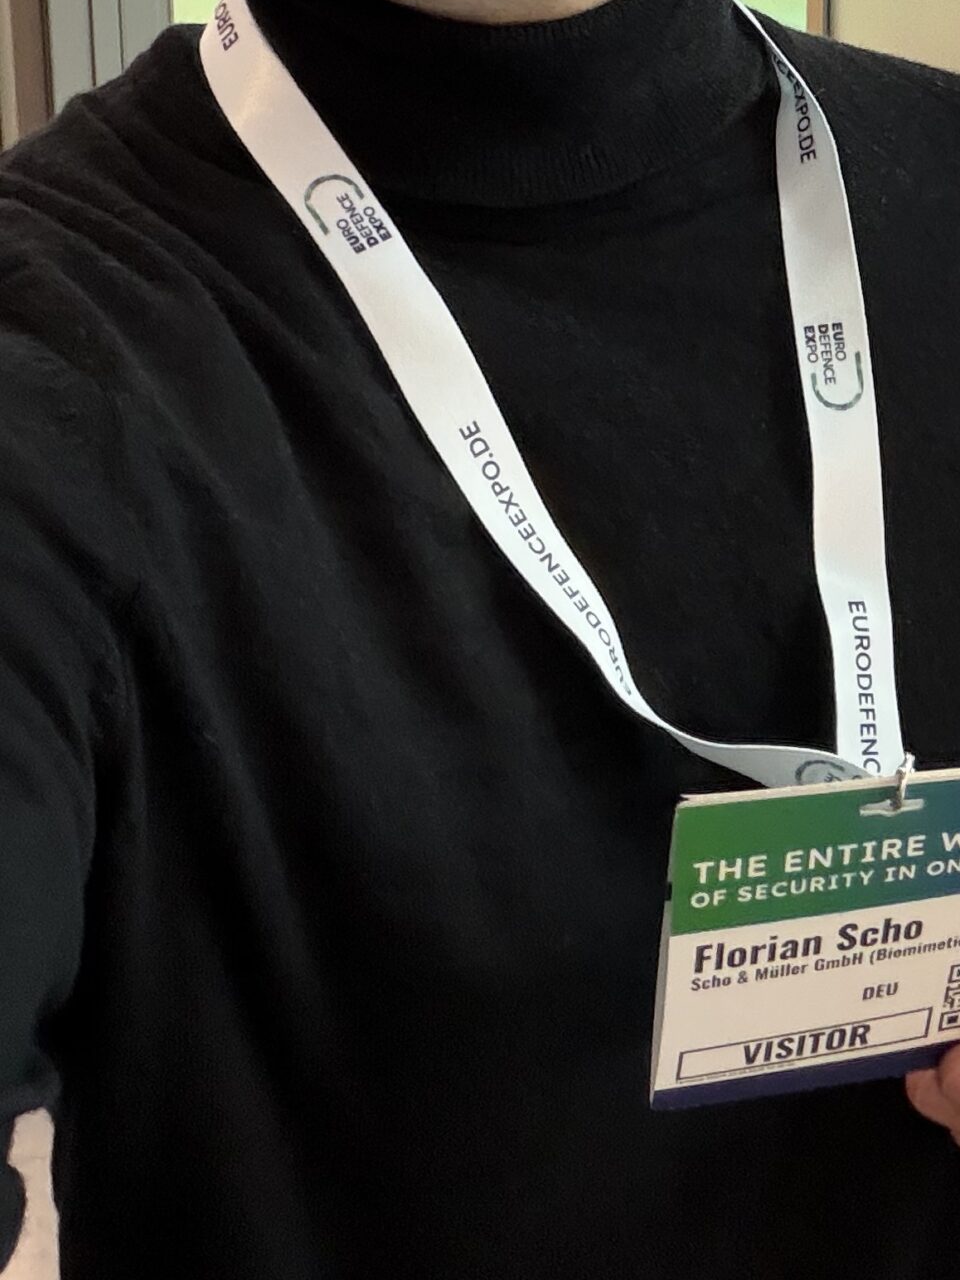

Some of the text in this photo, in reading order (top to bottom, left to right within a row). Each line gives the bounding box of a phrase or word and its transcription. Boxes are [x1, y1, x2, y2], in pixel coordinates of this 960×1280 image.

[336, 192, 380, 248] DEFENCE
[336, 218, 367, 254] EURO
[363, 206, 393, 242] EXPO
[803, 325, 819, 364] EXPO
[818, 323, 837, 386] DEFENCE
[831, 322, 847, 362] EURO
[693, 854, 767, 885] THE
[784, 834, 926, 873] ENTIRE
[690, 888, 728, 909] OF
[736, 869, 875, 903] SECURITY
[883, 864, 916, 883] IN
[693, 917, 924, 975] Florian Scho
[690, 974, 732, 992] Scho
[736, 970, 749, 984] &
[754, 962, 809, 983] Müller
[814, 951, 864, 972] GmbH
[862, 981, 899, 1001] DEU
[743, 1023, 872, 1066] VISITOR
